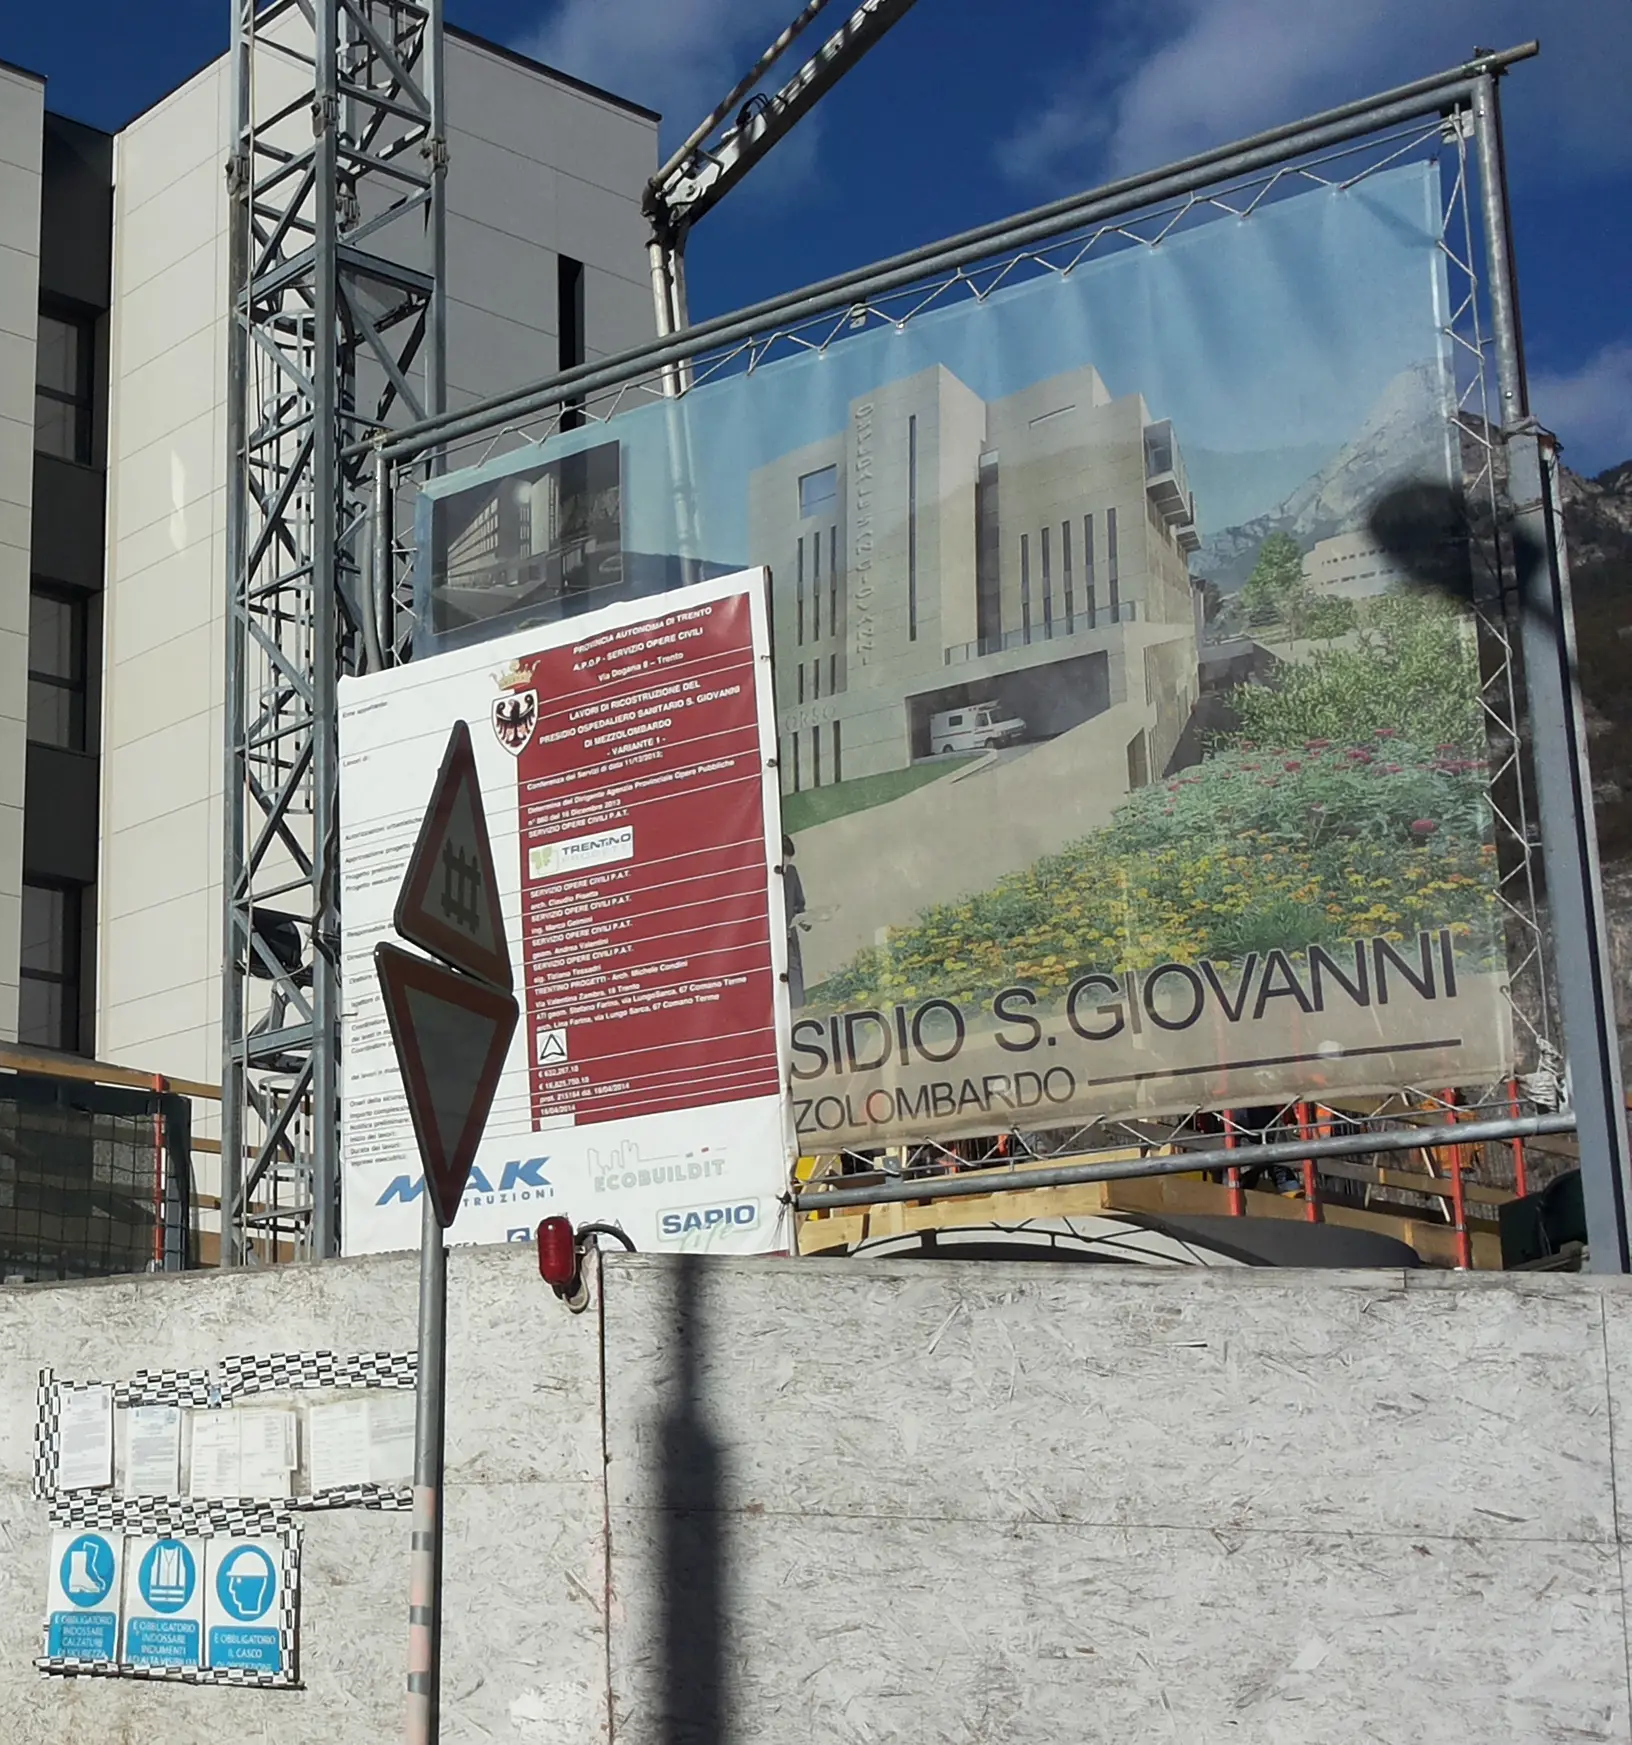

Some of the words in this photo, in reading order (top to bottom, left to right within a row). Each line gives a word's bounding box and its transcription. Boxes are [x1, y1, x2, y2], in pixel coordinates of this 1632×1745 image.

[573, 635, 613, 654] PROVINCIA
[615, 620, 664, 640] AUTONOMA
[665, 617, 674, 626] DI
[676, 606, 712, 623] TRENTO
[607, 643, 643, 661] SERVIZIO
[646, 634, 675, 649] OPERE
[678, 626, 703, 640] CIVILI
[598, 672, 609, 682] Via
[657, 651, 683, 665] Trento
[569, 705, 599, 721] LAVORI
[600, 703, 608, 712] DI
[610, 684, 680, 710] RICOSTRUZIONE
[682, 679, 700, 691] DEL
[539, 727, 575, 744] PRESIDIO
[577, 711, 635, 734] OSPEDALIERO
[637, 699, 683, 718] SANITARIO
[685, 696, 693, 706] S.
[696, 684, 740, 703] GIOVANNI
[584, 739, 592, 748] DI
[594, 718, 671, 745] MEZZOLOMBARDO
[611, 737, 653, 755] VARIANTE
[526, 775, 564, 791] Conferenza
[577, 766, 598, 778] Servizi
[697, 758, 734, 775] Pubbliche
[571, 802, 602, 816] Dicembre
[528, 824, 560, 838] SERVIZIO
[561, 818, 585, 831] OPERE
[587, 813, 607, 825] CIVILI
[530, 885, 562, 898] SERVIZIO
[563, 879, 587, 891] OPERE
[589, 874, 609, 886] CIVILI
[531, 909, 562, 922] SERVIZIO
[564, 904, 588, 915] OPERE
[590, 899, 610, 910] CIVILI
[532, 934, 563, 947] SERVIZIO
[565, 928, 589, 940] OPERE
[591, 924, 611, 935] CIVILI
[532, 958, 564, 971] SERVIZIO
[566, 953, 590, 965] OPERE
[592, 949, 612, 960] CIVILI
[534, 983, 568, 996] TRENTINO
[570, 976, 606, 989] PROGETTI
[791, 999, 965, 1080] SIDIO
[792, 1065, 1076, 1134] ZOLOMBARDO
[593, 1158, 725, 1193] ECOBUILDIT
[662, 1204, 755, 1234] SAPIO
[139, 1621, 196, 1633] OBBLIGATORIO
[220, 1634, 276, 1645] OBBLIGATORIO
[235, 1648, 263, 1659] CASCO
